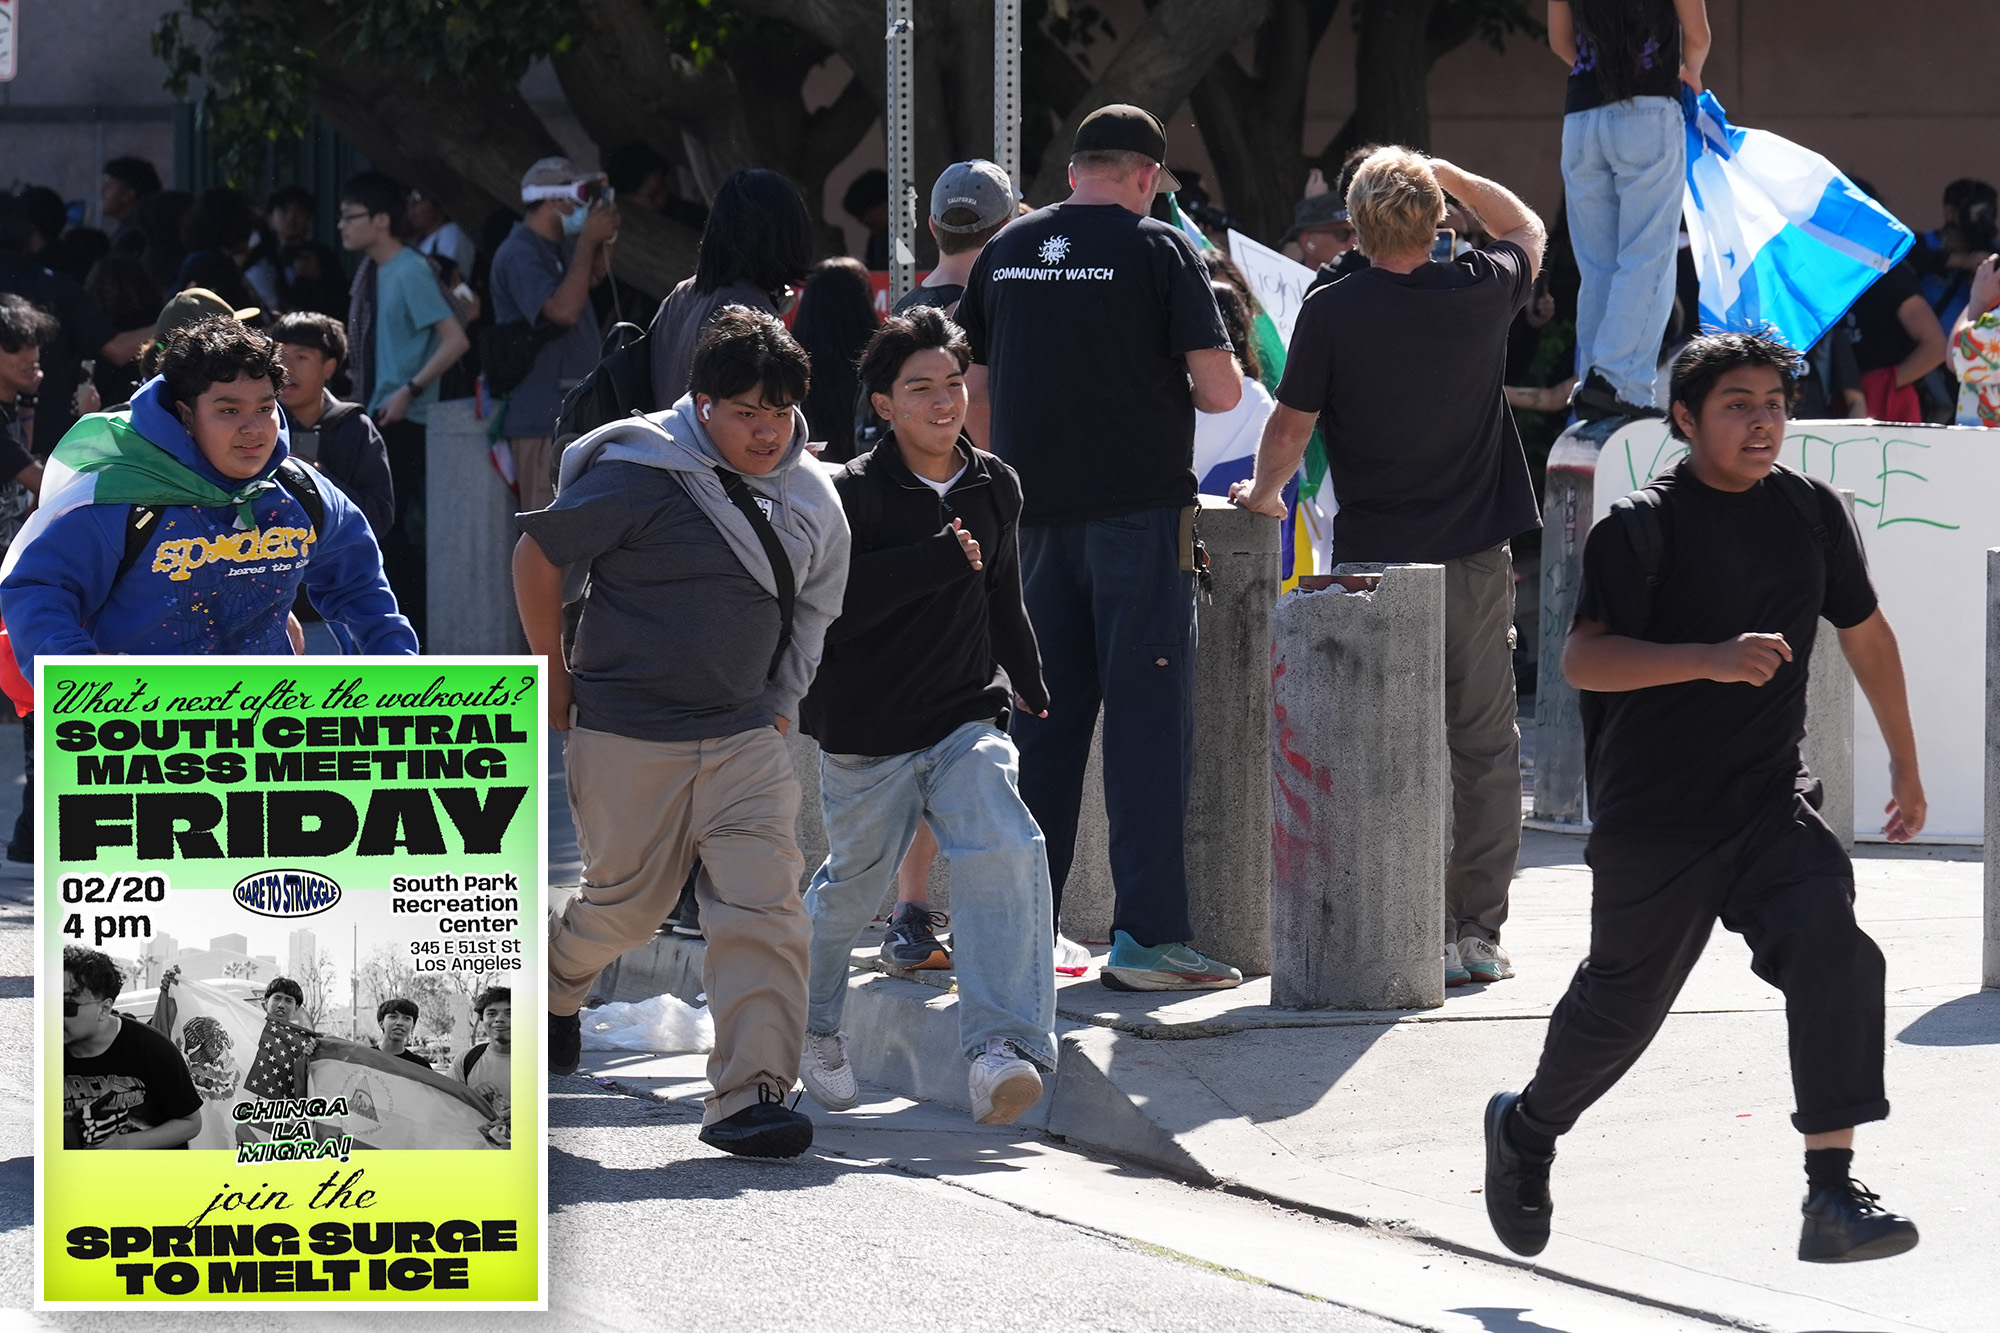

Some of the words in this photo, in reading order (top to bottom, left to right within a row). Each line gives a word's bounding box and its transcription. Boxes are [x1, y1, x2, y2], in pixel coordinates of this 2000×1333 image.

[947, 196, 977, 206] CALIFORNIA
[992, 267, 1064, 282] COMMUNITY
[1065, 267, 1115, 281] WATCH
[271, 562, 293, 573] the
